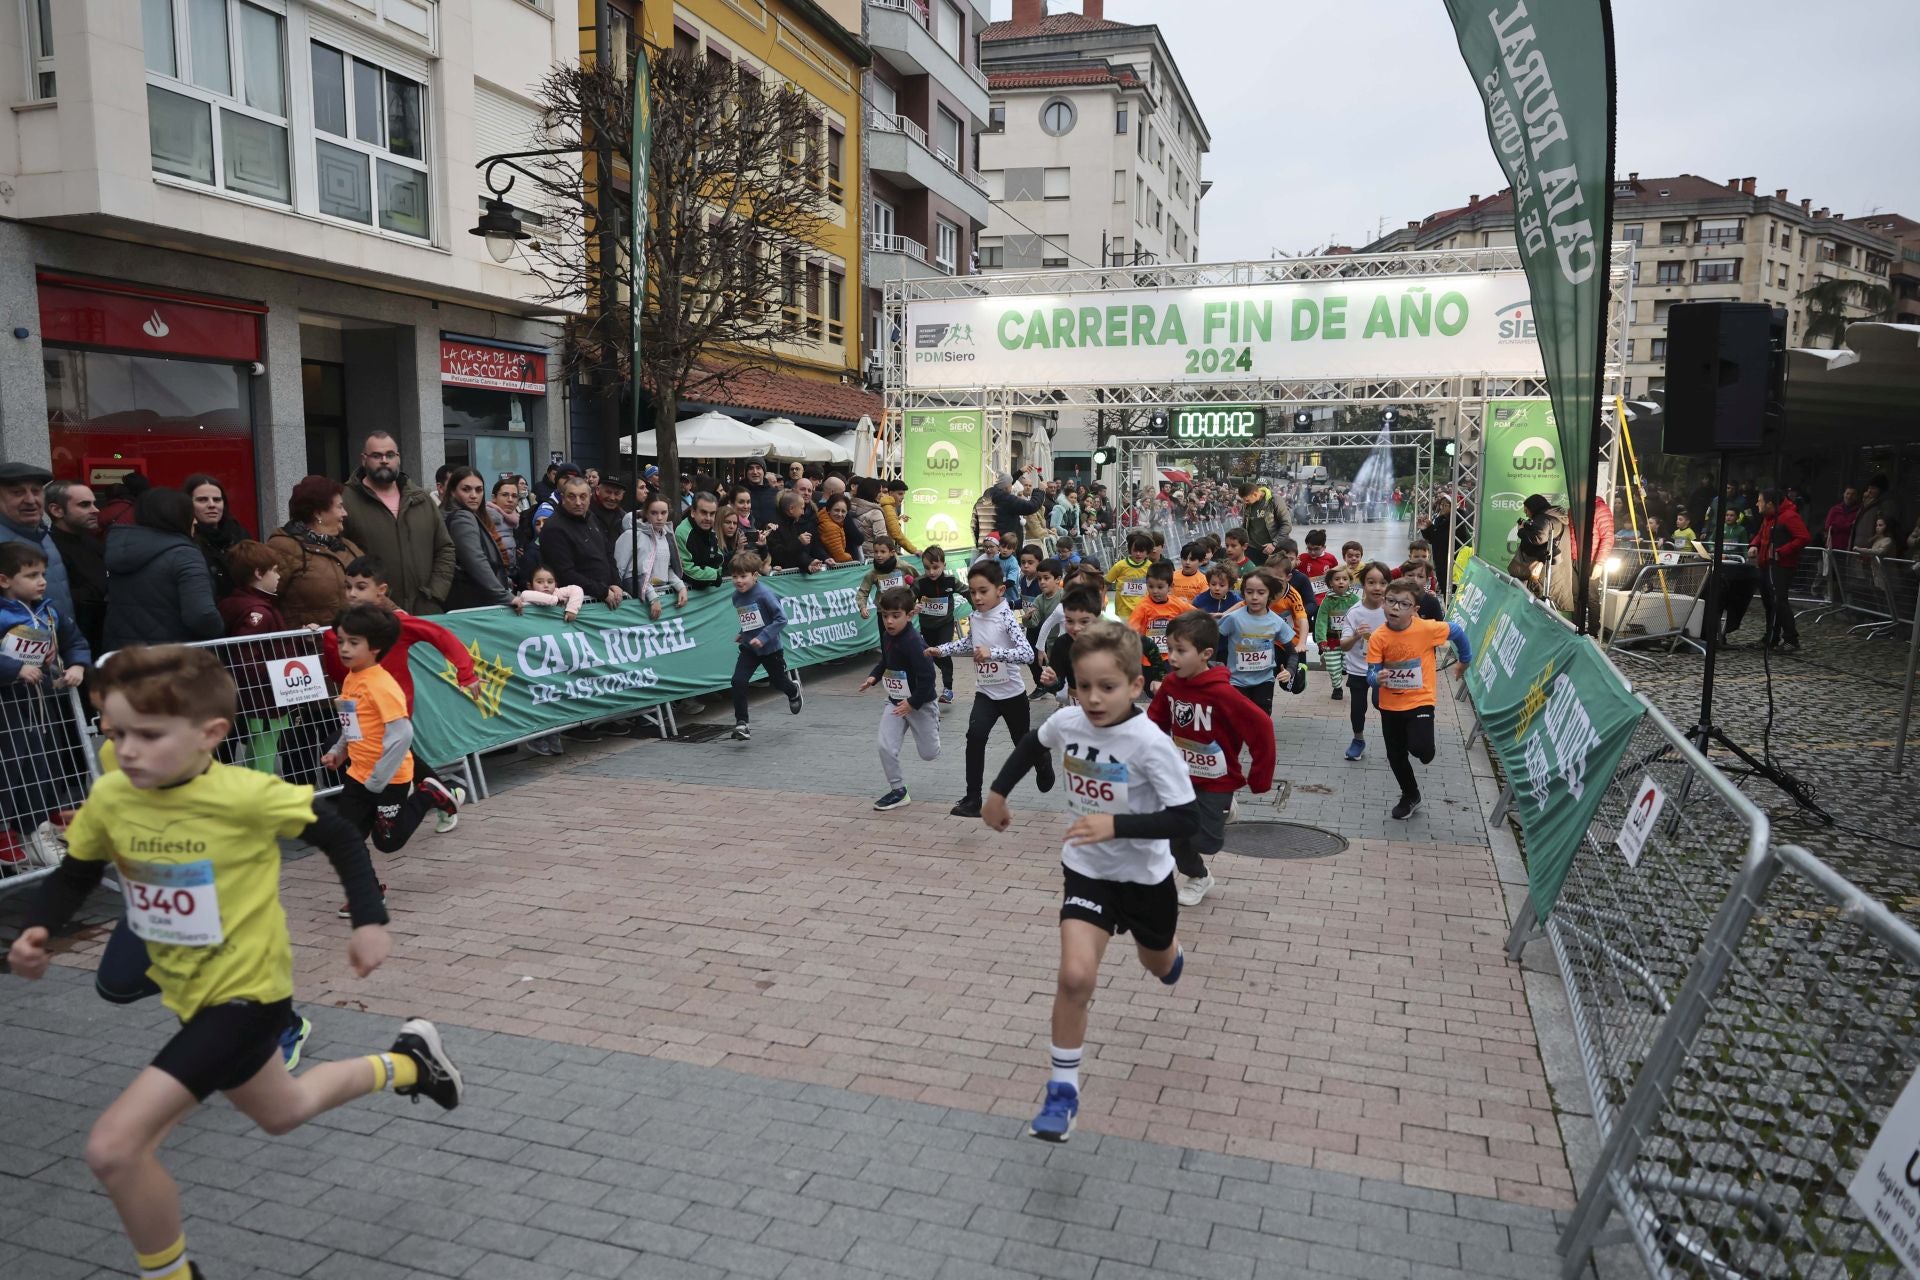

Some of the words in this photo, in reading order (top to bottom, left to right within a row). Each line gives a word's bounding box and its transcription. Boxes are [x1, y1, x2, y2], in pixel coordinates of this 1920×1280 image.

[997, 303, 1188, 351] CARRERA
[1203, 300, 1273, 345] FIN
[1291, 296, 1348, 342] DE
[1362, 286, 1469, 339] AÑO
[1498, 310, 1537, 339] SIE
[443, 347, 458, 359] LA
[460, 349, 491, 362] CASA
[493, 352, 505, 364] DE
[507, 354, 526, 366] LAS
[915, 352, 975, 363] PDMSiero
[1185, 346, 1253, 374] 2024
[449, 361, 519, 379] MASCOTAS
[949, 422, 976, 433] SIERO
[1178, 411, 1255, 437] 00:00:02
[1491, 499, 1524, 512] SIERO
[882, 577, 900, 587] 1267
[1127, 582, 1143, 591] 1316
[780, 593, 826, 626] CAJA
[788, 631, 806, 650] DE
[808, 620, 858, 647] ASTURIAS
[517, 631, 605, 678] CAJA
[599, 617, 697, 665] RURAL
[1241, 651, 1267, 662] 1284
[285, 675, 312, 688] wip
[564, 667, 659, 700] ASTURIAS
[1388, 669, 1416, 680] 244
[884, 678, 903, 690] 1253
[1181, 749, 1217, 767] 1288
[1067, 771, 1115, 802] 1266
[1080, 797, 1099, 808] LUCA
[130, 836, 206, 854] Infiesto
[126, 881, 195, 916] 1340
